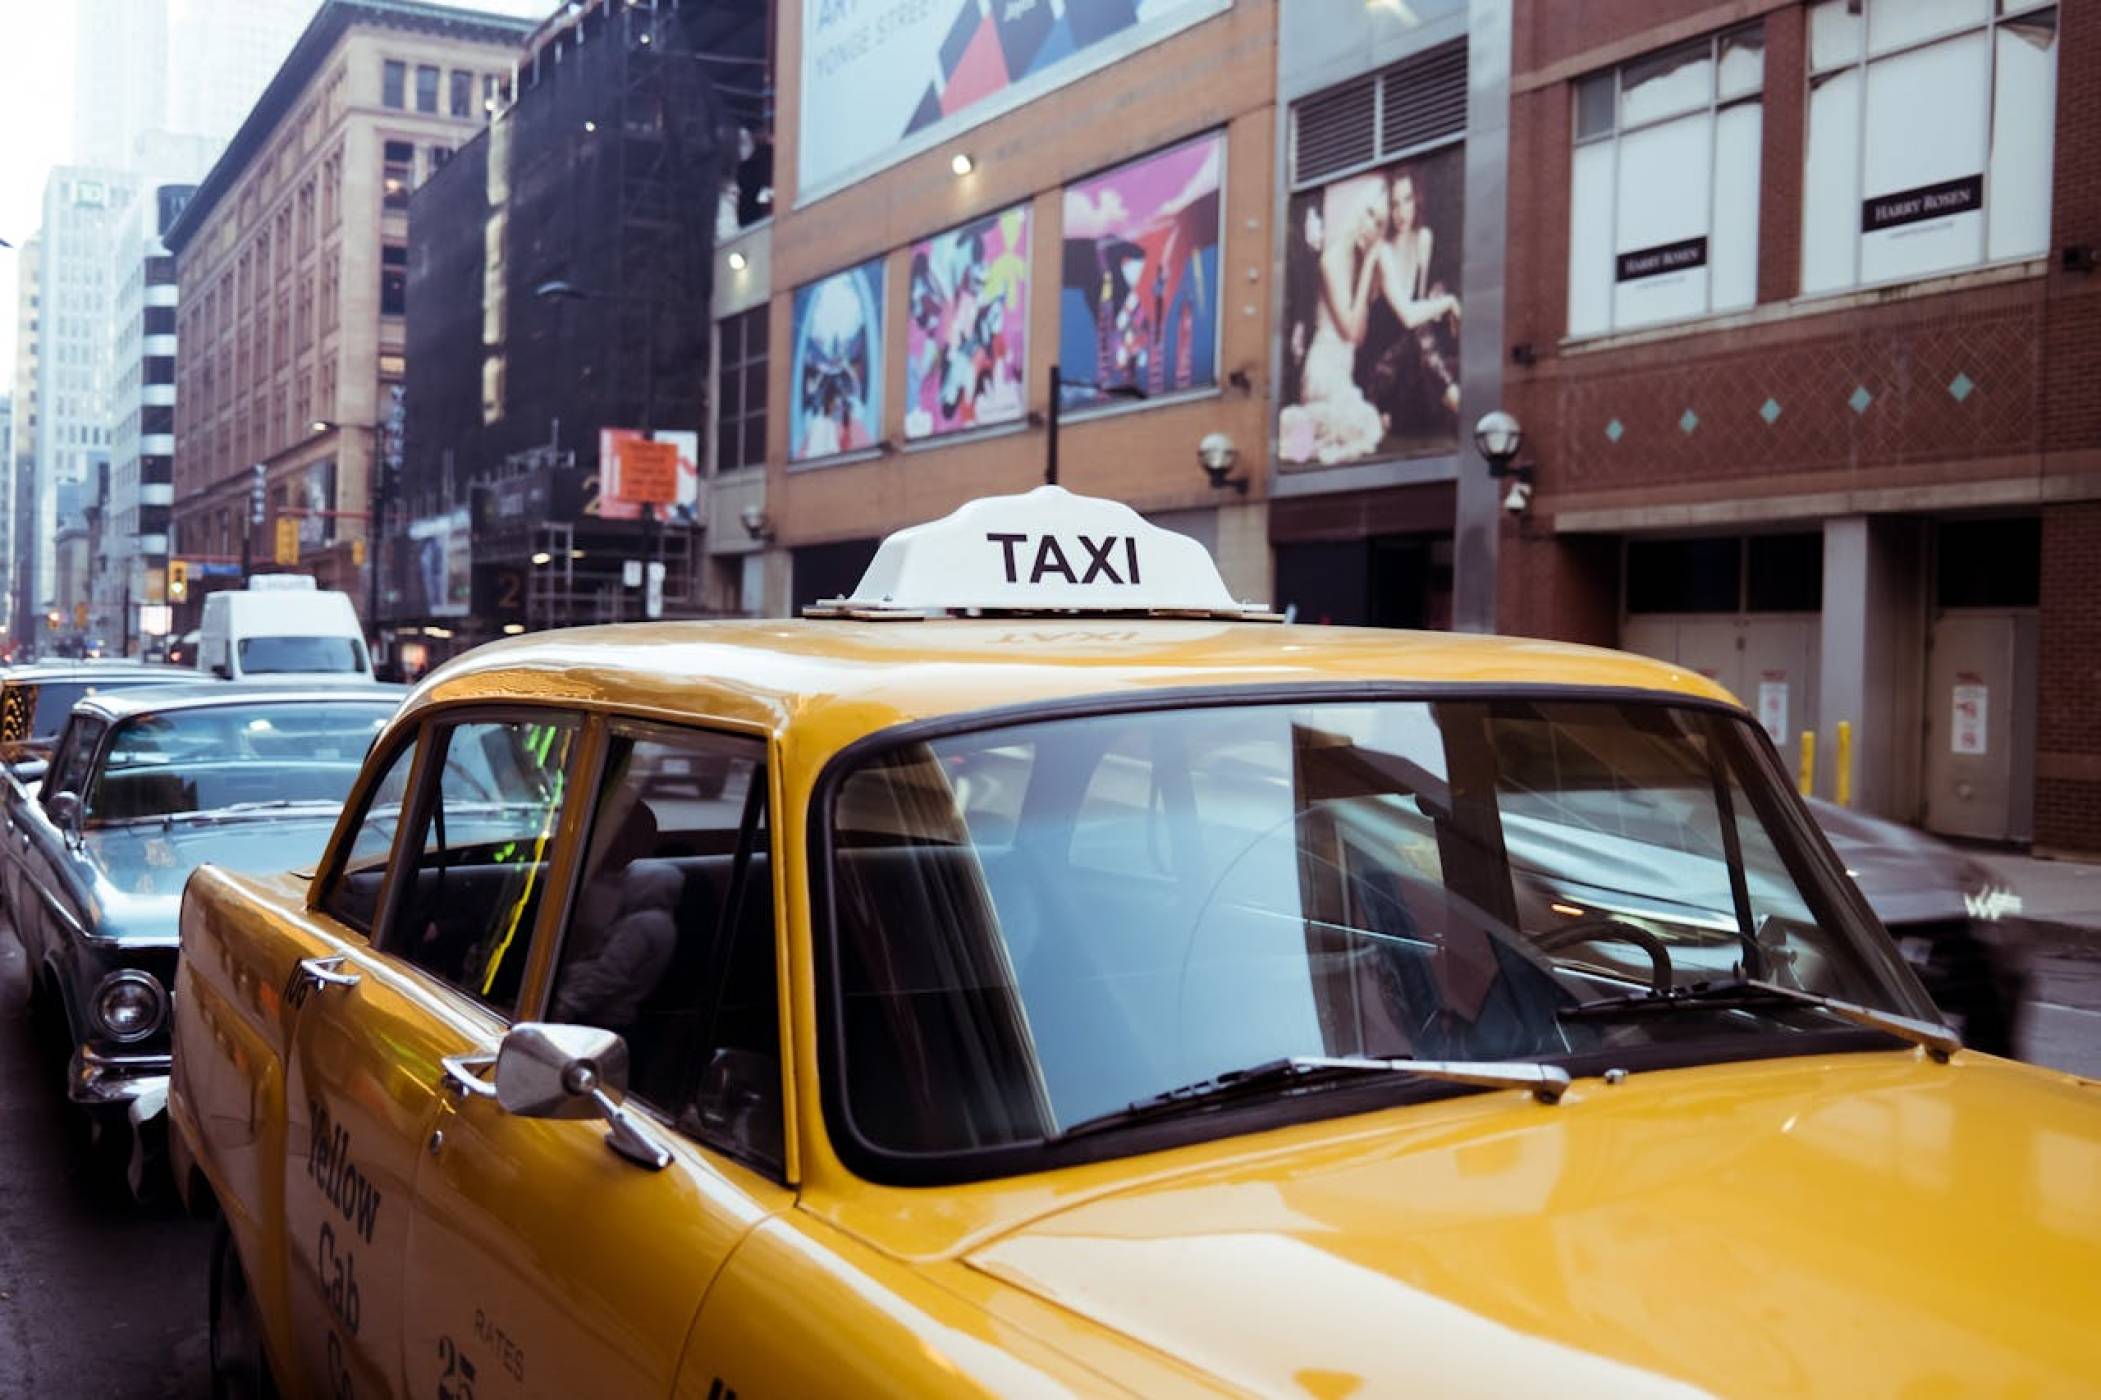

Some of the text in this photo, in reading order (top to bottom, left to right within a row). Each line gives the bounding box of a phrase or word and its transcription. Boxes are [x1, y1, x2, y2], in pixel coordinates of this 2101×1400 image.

[1875, 187, 1972, 222] HARRY ROSEN
[986, 532, 1141, 584] TAXI
[308, 1099, 381, 1244] Yellow
[319, 1221, 359, 1336] Cab
[474, 1307, 524, 1382] RATES
